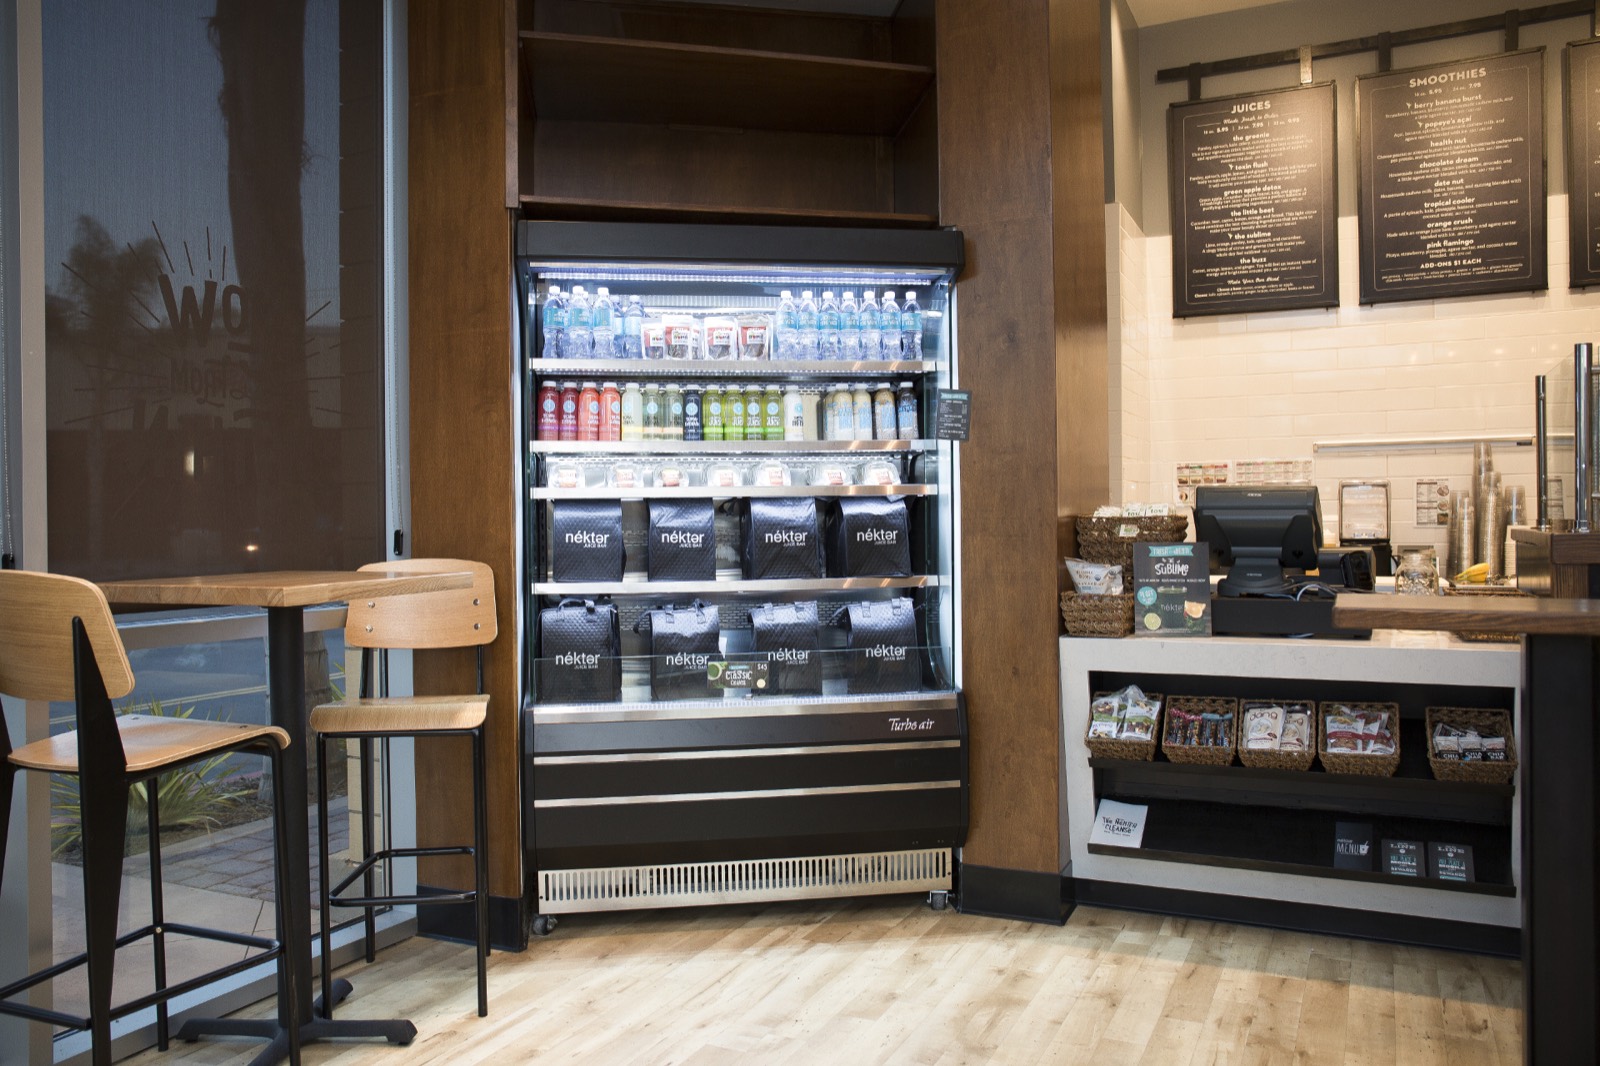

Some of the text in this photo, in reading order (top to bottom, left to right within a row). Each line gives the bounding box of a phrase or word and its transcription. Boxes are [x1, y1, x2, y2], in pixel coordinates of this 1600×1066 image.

[1409, 67, 1486, 87] SMOOTHIES
[1230, 100, 1270, 114] JUICES
[1414, 93, 1481, 109] berry banana burst
[1424, 118, 1455, 128] popeye's
[1245, 131, 1269, 141] greenie
[1430, 138, 1452, 147] health
[1252, 160, 1268, 168] flush
[1419, 158, 1453, 168] chocolate
[1455, 155, 1478, 163] dream
[1223, 183, 1281, 196] green apple detox
[1424, 196, 1475, 208] tropical cooler
[1427, 217, 1472, 228] orange crush
[1246, 230, 1271, 238] sublime
[1426, 237, 1473, 249] pink flamingo
[1251, 255, 1266, 263] buzz
[888, 717, 935, 732] Turbo air
[1336, 842, 1359, 854] MENU
